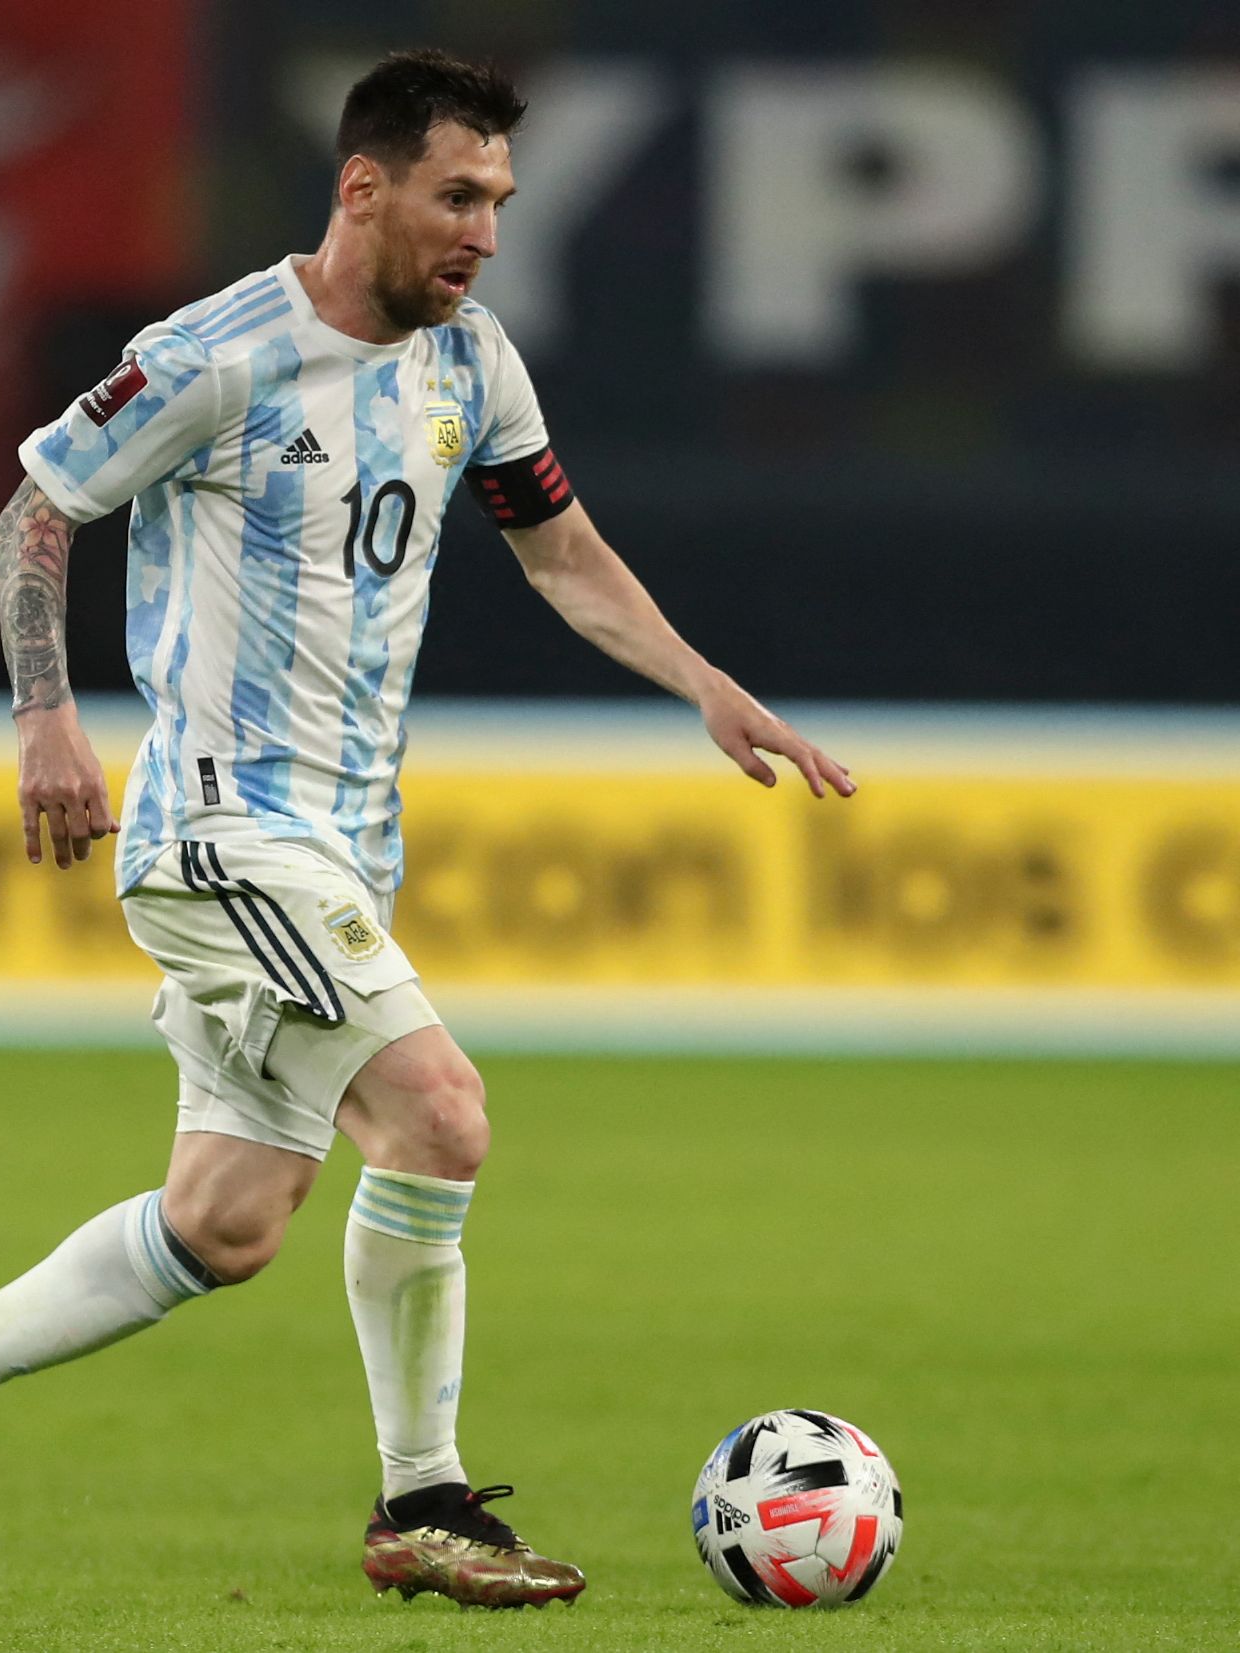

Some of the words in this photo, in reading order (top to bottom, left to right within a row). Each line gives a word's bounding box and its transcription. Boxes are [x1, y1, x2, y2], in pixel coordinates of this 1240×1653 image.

[437, 420, 459, 448] AFA
[280, 449, 330, 465] adidas
[340, 478, 416, 579] 10
[341, 920, 369, 945] AFA
[713, 1494, 751, 1524] adidas
